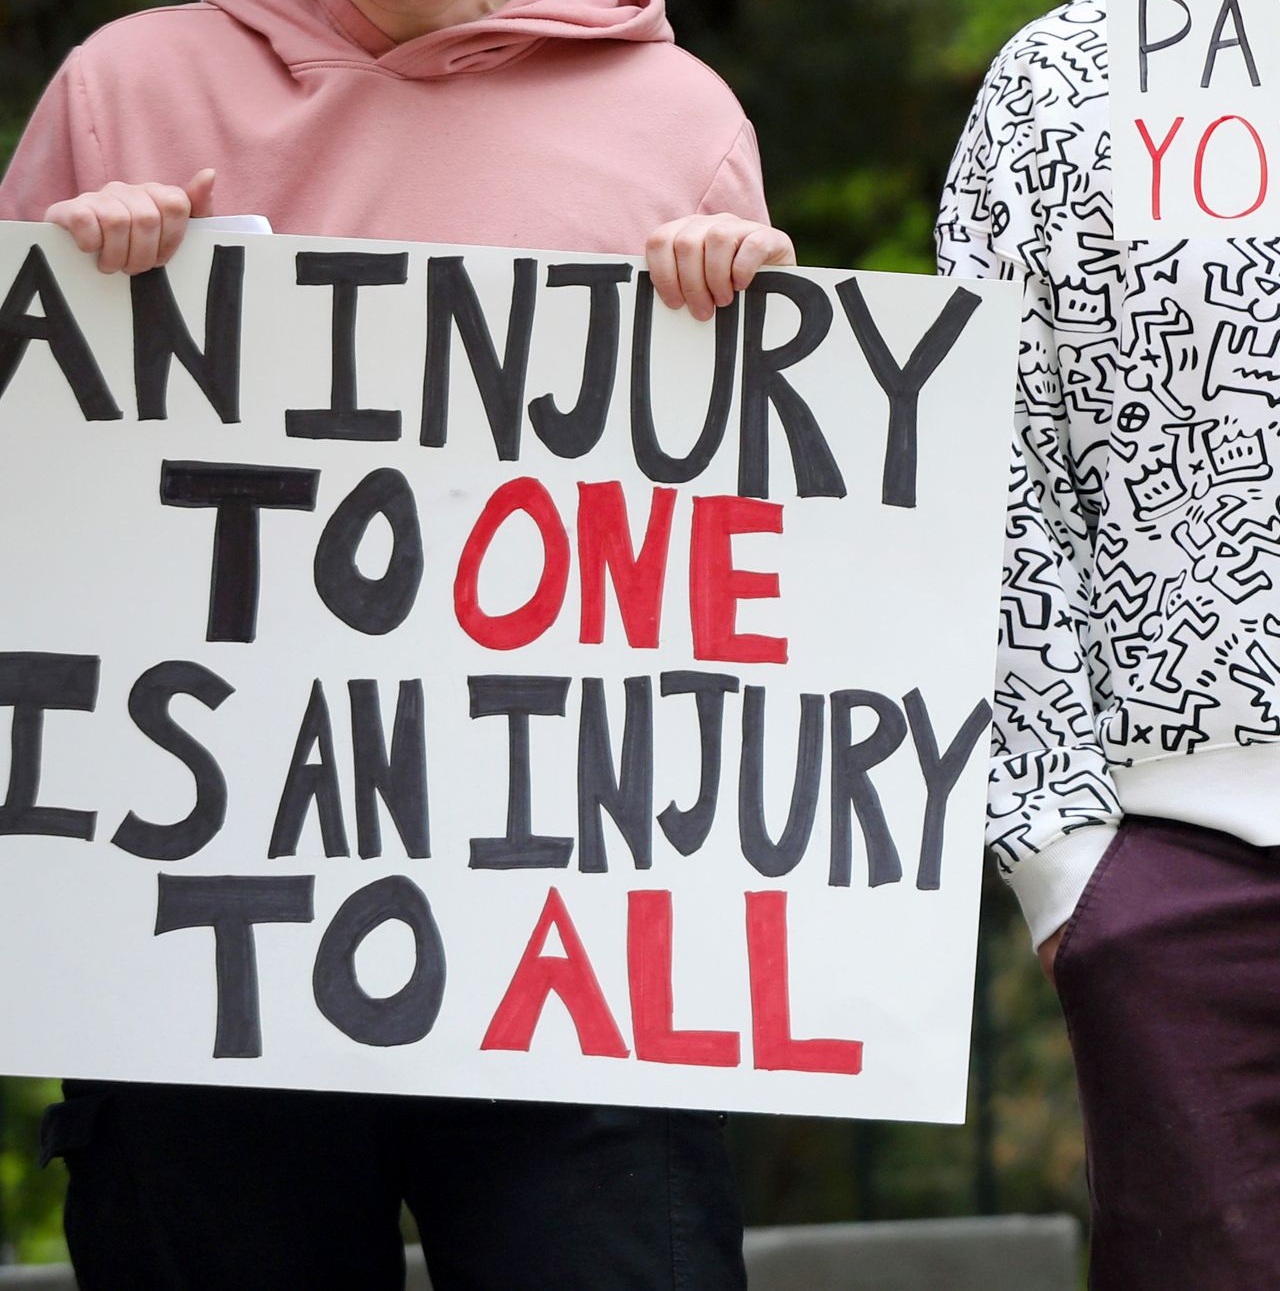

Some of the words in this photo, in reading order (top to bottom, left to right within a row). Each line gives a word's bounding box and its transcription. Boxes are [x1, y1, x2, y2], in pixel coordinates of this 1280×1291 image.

[0, 243, 246, 424] AN
[285, 248, 983, 508] INJURY
[159, 459, 424, 644] TO
[453, 476, 789, 666] ONE
[0, 651, 237, 861] IS
[267, 677, 432, 860] AN
[467, 669, 994, 891] INJURY
[154, 872, 446, 1059] TO
[479, 885, 864, 1076] ALL
